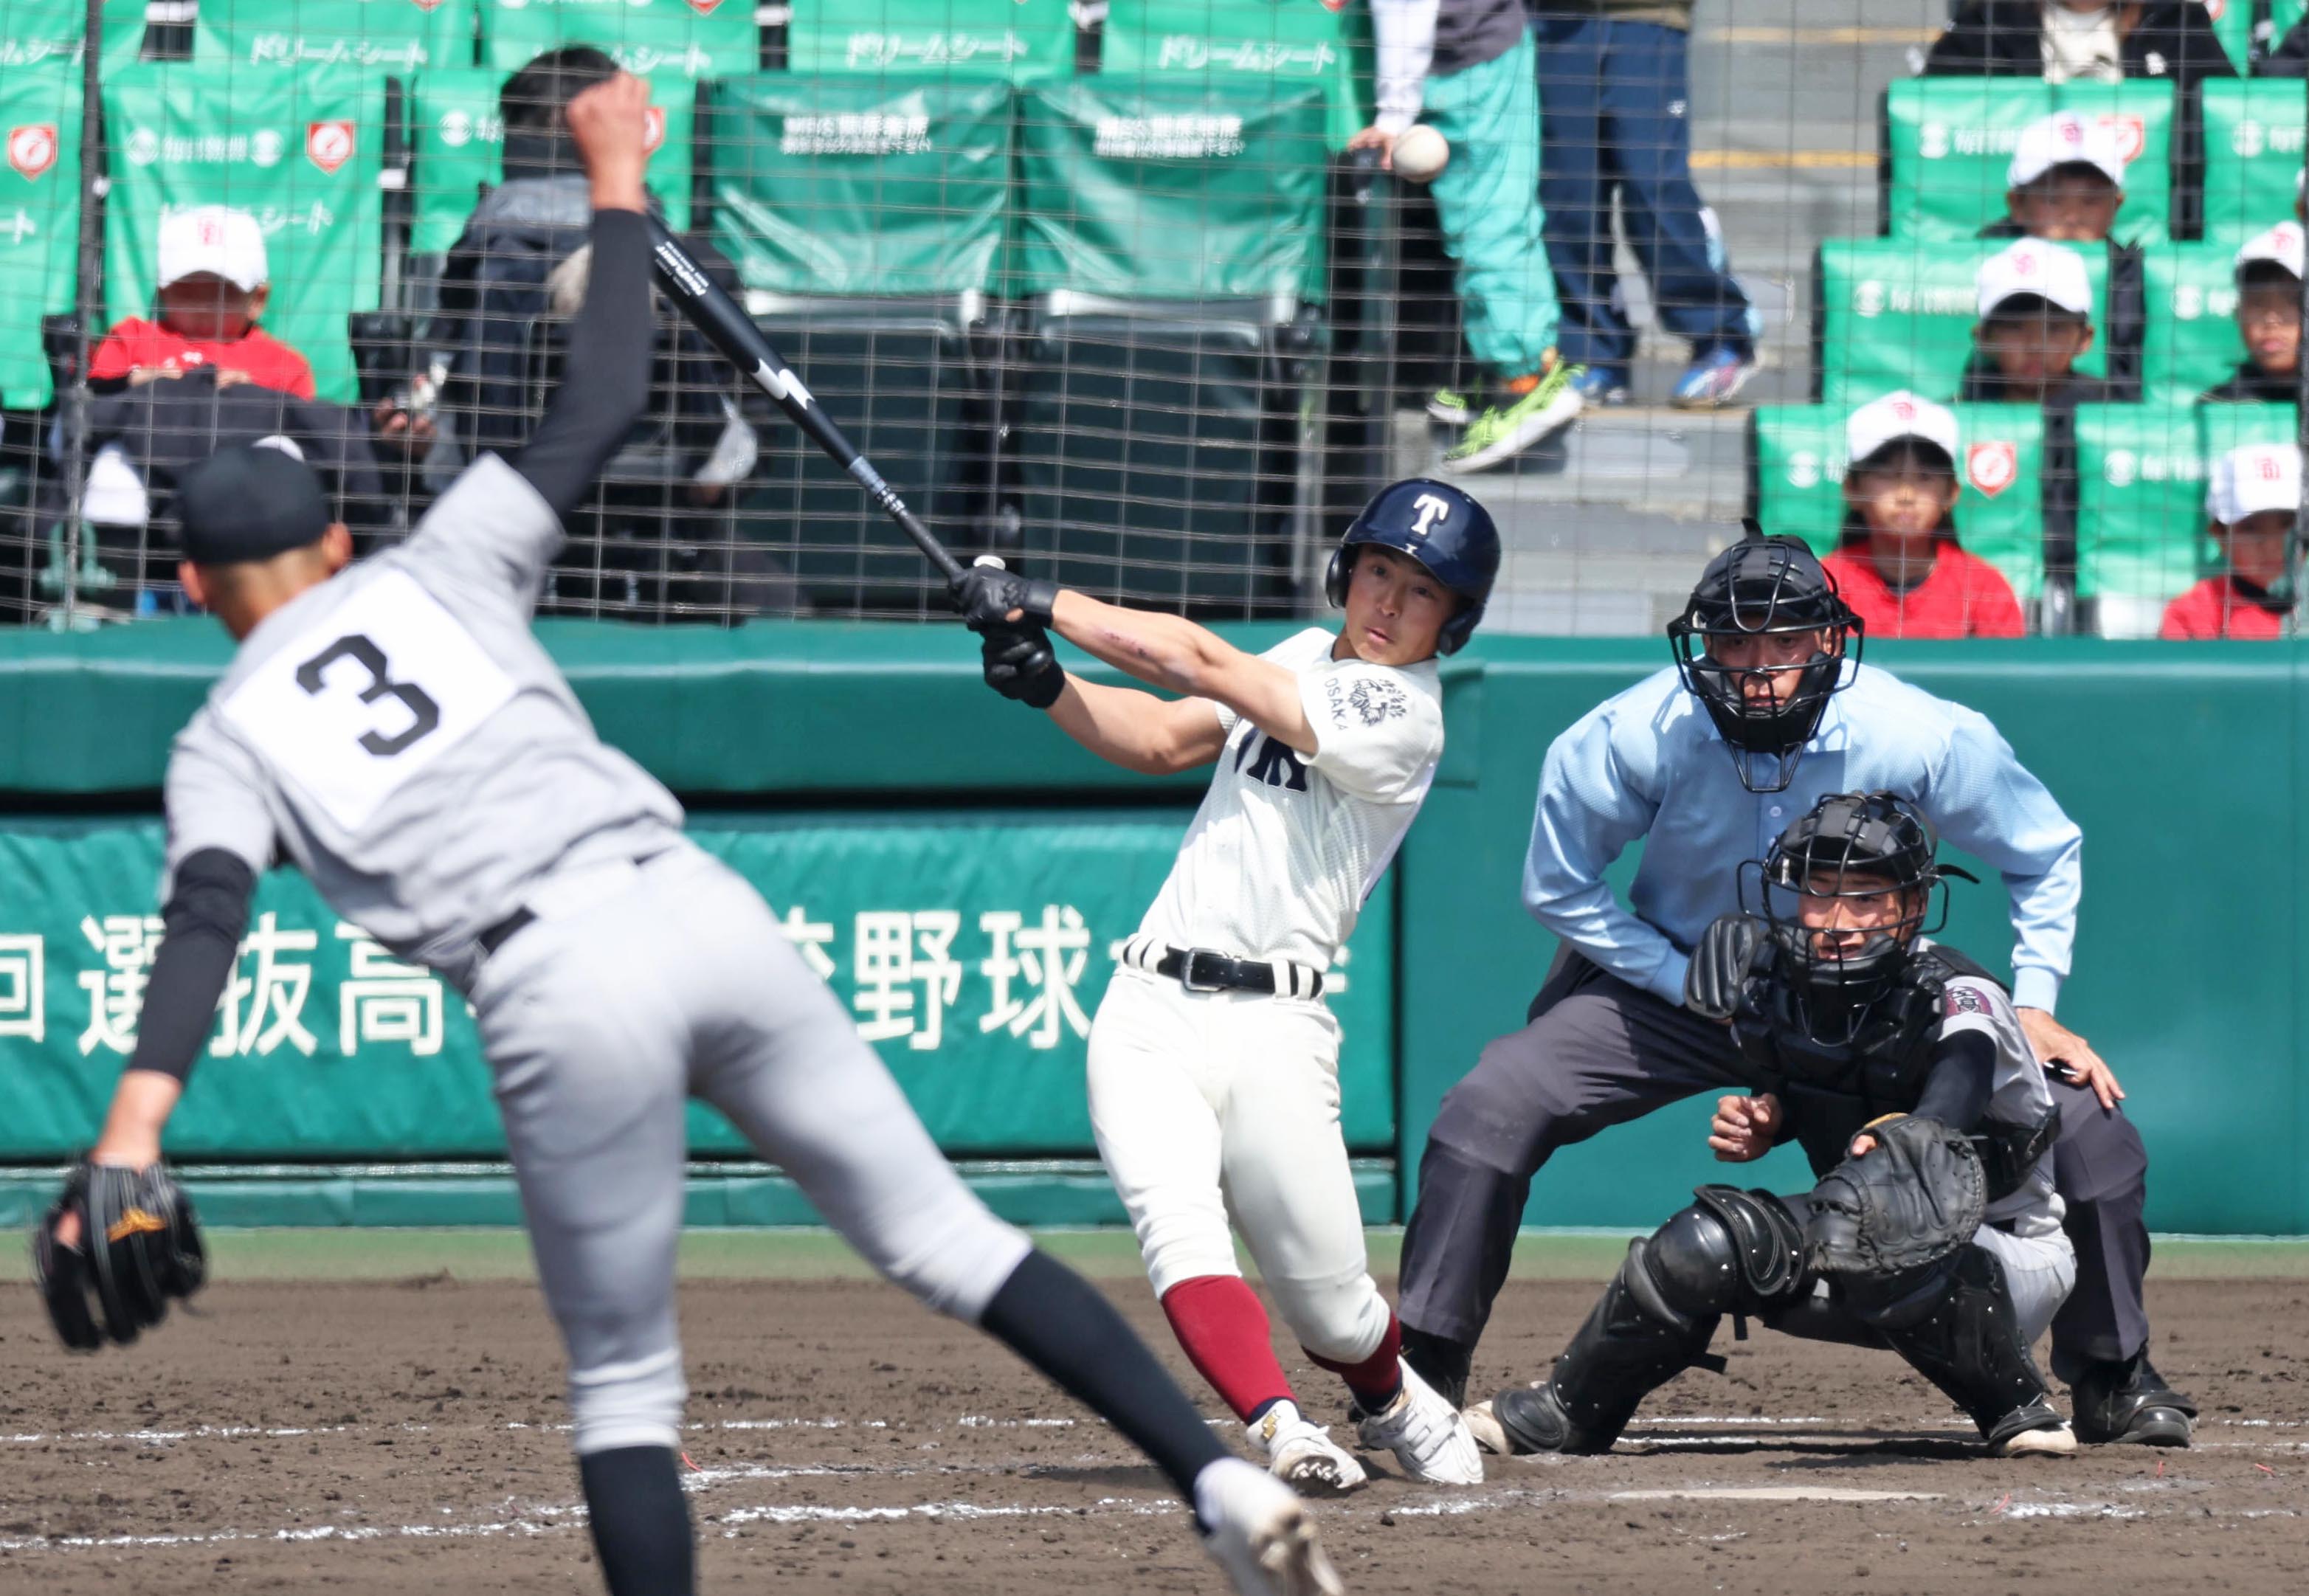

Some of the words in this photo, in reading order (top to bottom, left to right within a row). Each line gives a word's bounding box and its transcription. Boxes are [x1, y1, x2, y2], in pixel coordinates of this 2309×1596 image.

[844, 32, 1030, 69] ドリームシート
[1157, 35, 1337, 75] ドリームシート
[1411, 494, 1449, 536] T
[296, 634, 439, 756] 3
